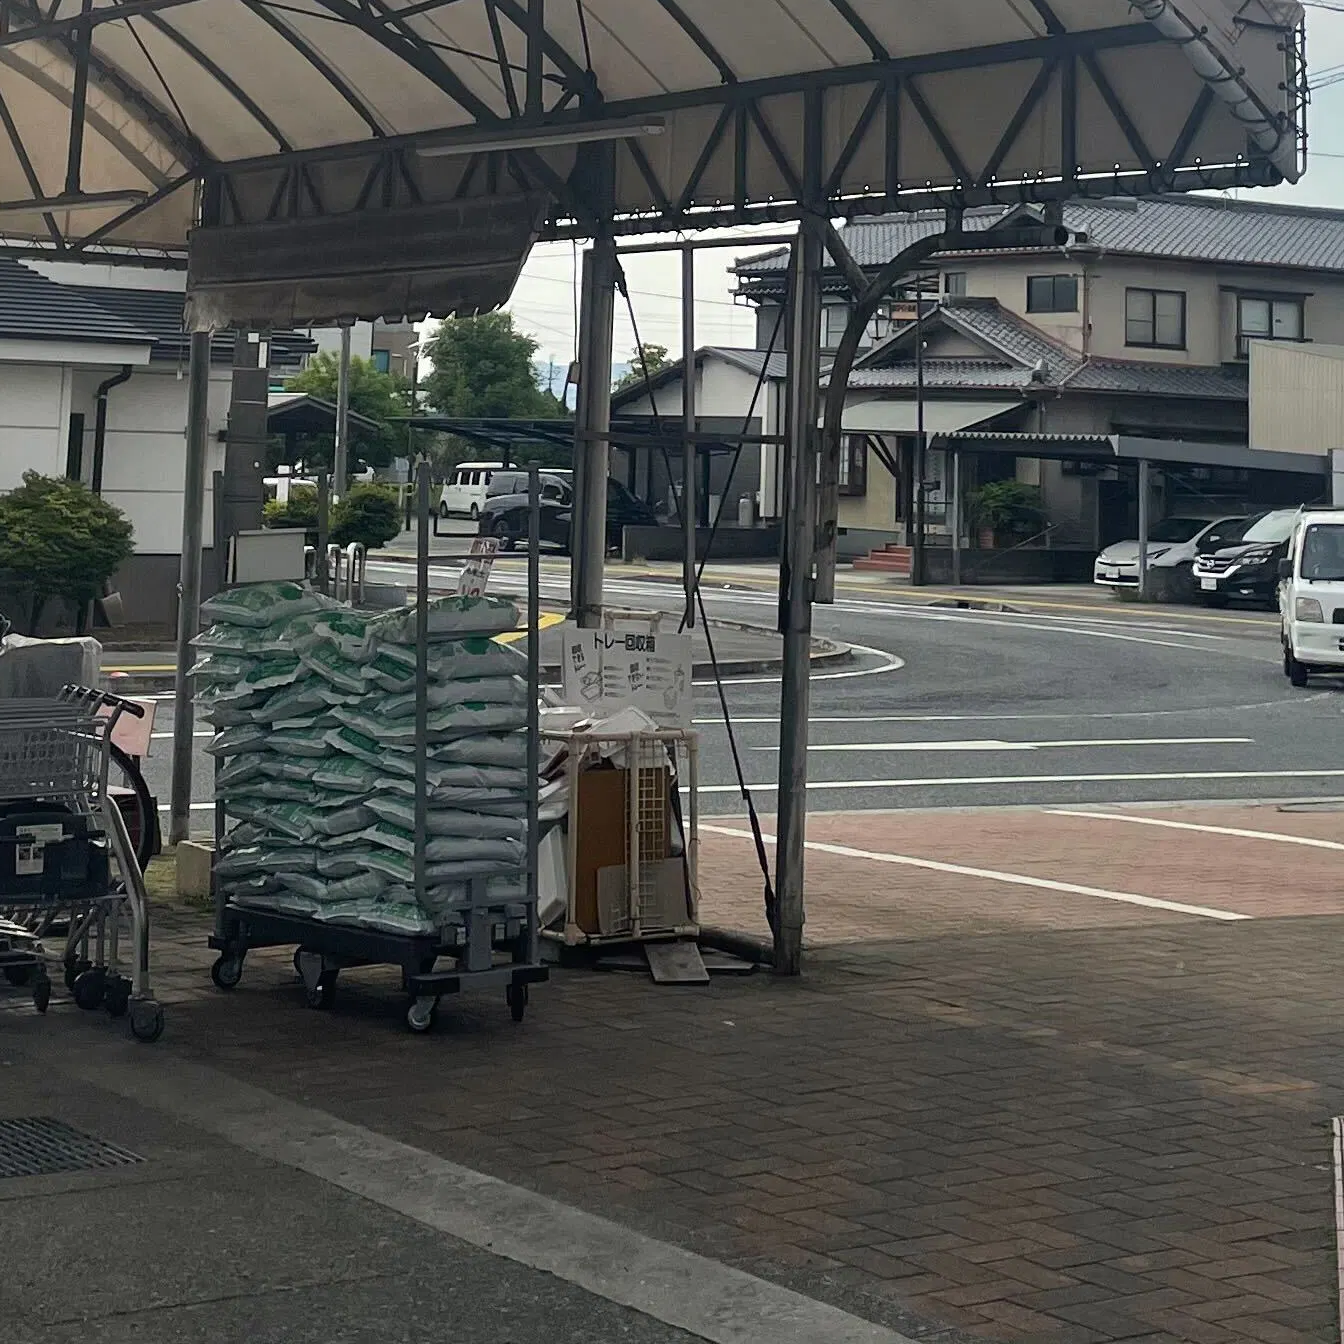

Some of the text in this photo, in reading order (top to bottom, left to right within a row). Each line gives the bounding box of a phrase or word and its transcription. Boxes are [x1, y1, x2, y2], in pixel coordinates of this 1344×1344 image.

[594, 632, 655, 653] トレー回収箱
